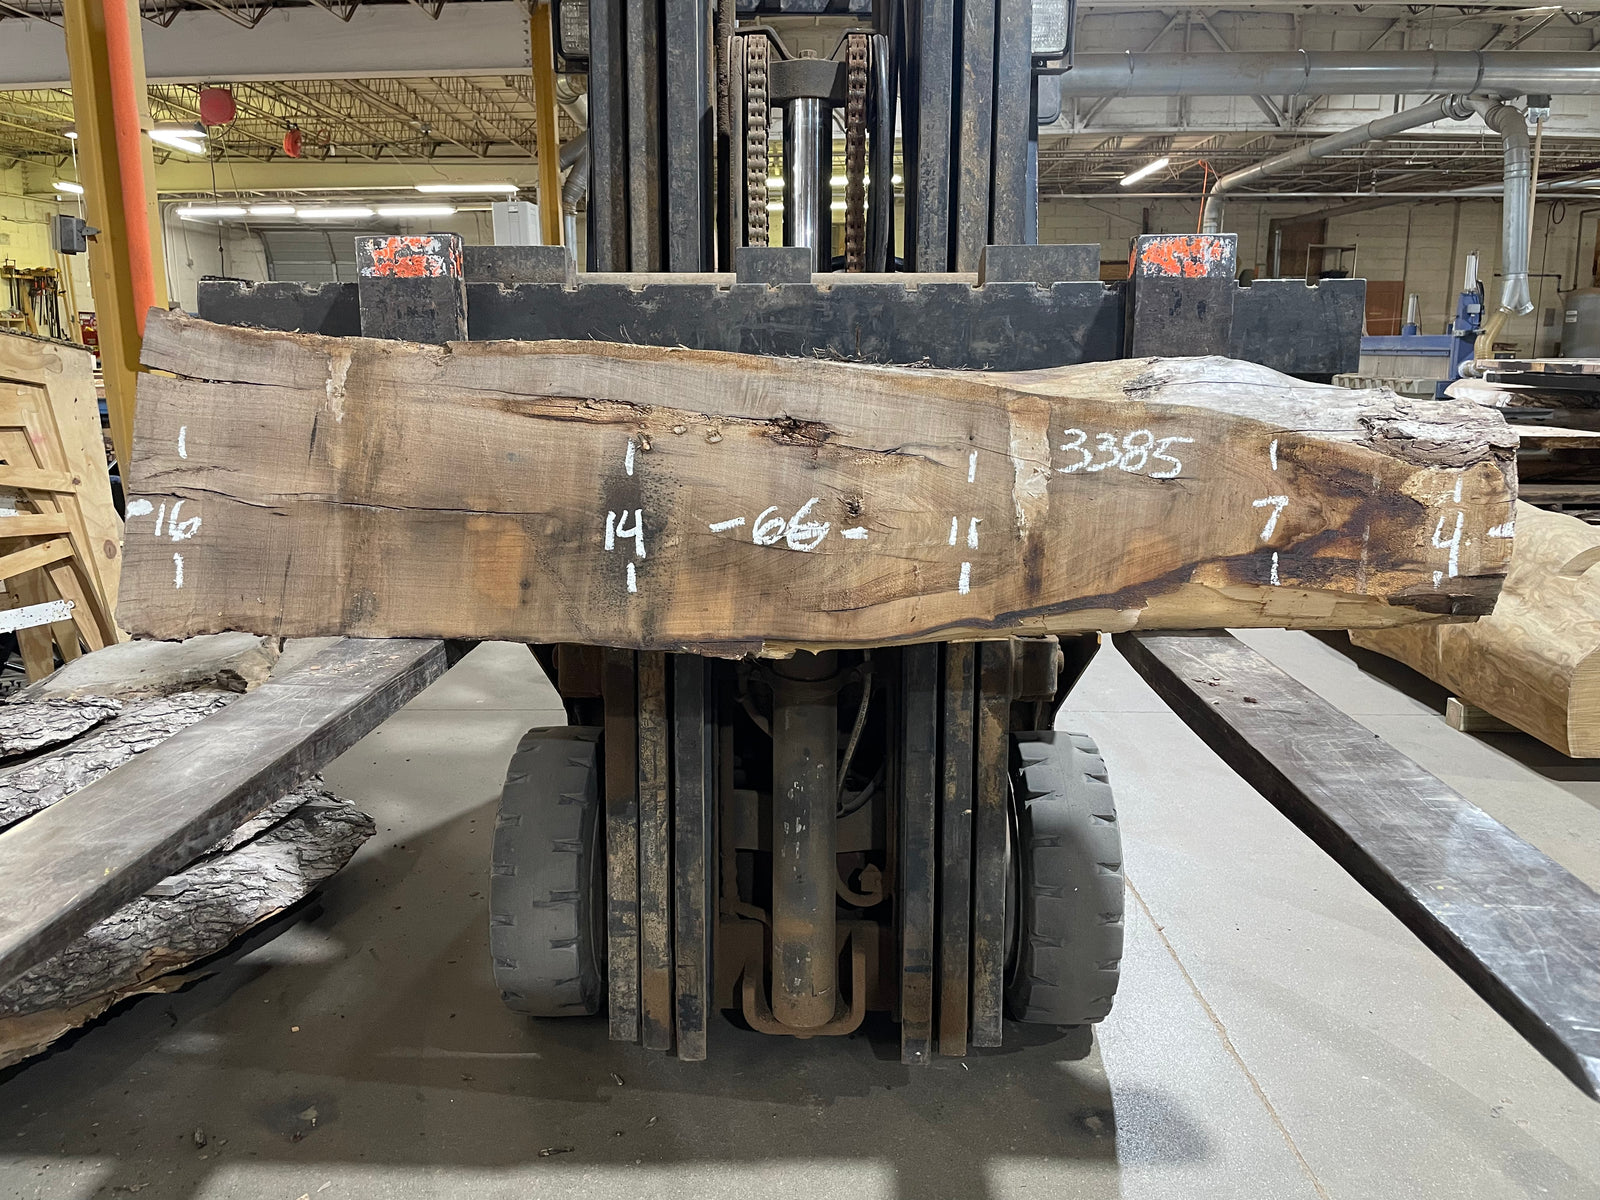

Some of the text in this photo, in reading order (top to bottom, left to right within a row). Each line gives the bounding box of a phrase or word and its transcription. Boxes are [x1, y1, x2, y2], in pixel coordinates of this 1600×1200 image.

[1059, 427, 1195, 479] 3385
[604, 508, 648, 558] 14
[1252, 495, 1289, 542] 7
[1431, 511, 1464, 578] 4
